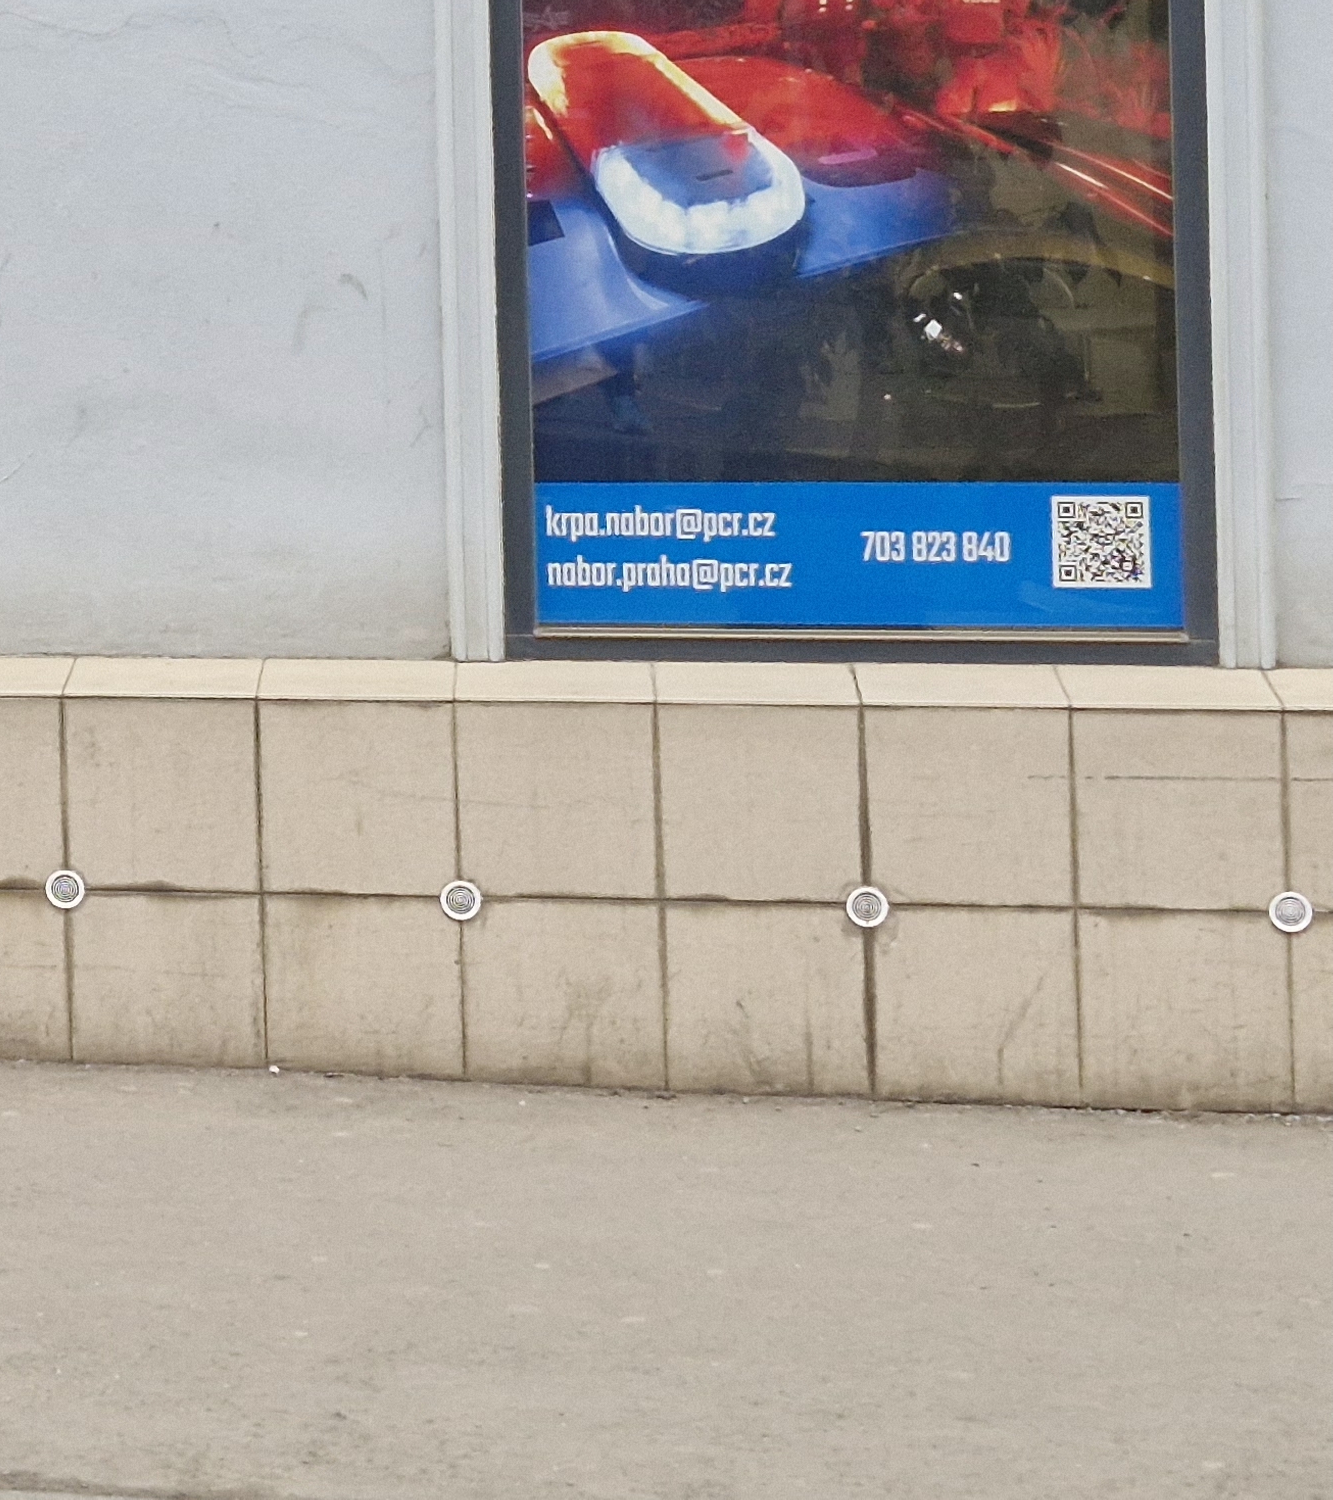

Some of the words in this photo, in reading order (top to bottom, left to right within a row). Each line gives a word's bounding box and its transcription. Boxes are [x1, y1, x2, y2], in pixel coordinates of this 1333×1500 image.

[545, 504, 777, 543] krpa.nabor@pcr.cz
[860, 530, 906, 562] 703
[911, 531, 957, 562] 823
[961, 531, 1011, 562] 840
[547, 554, 794, 593] nabor.praha@pcr.cz
